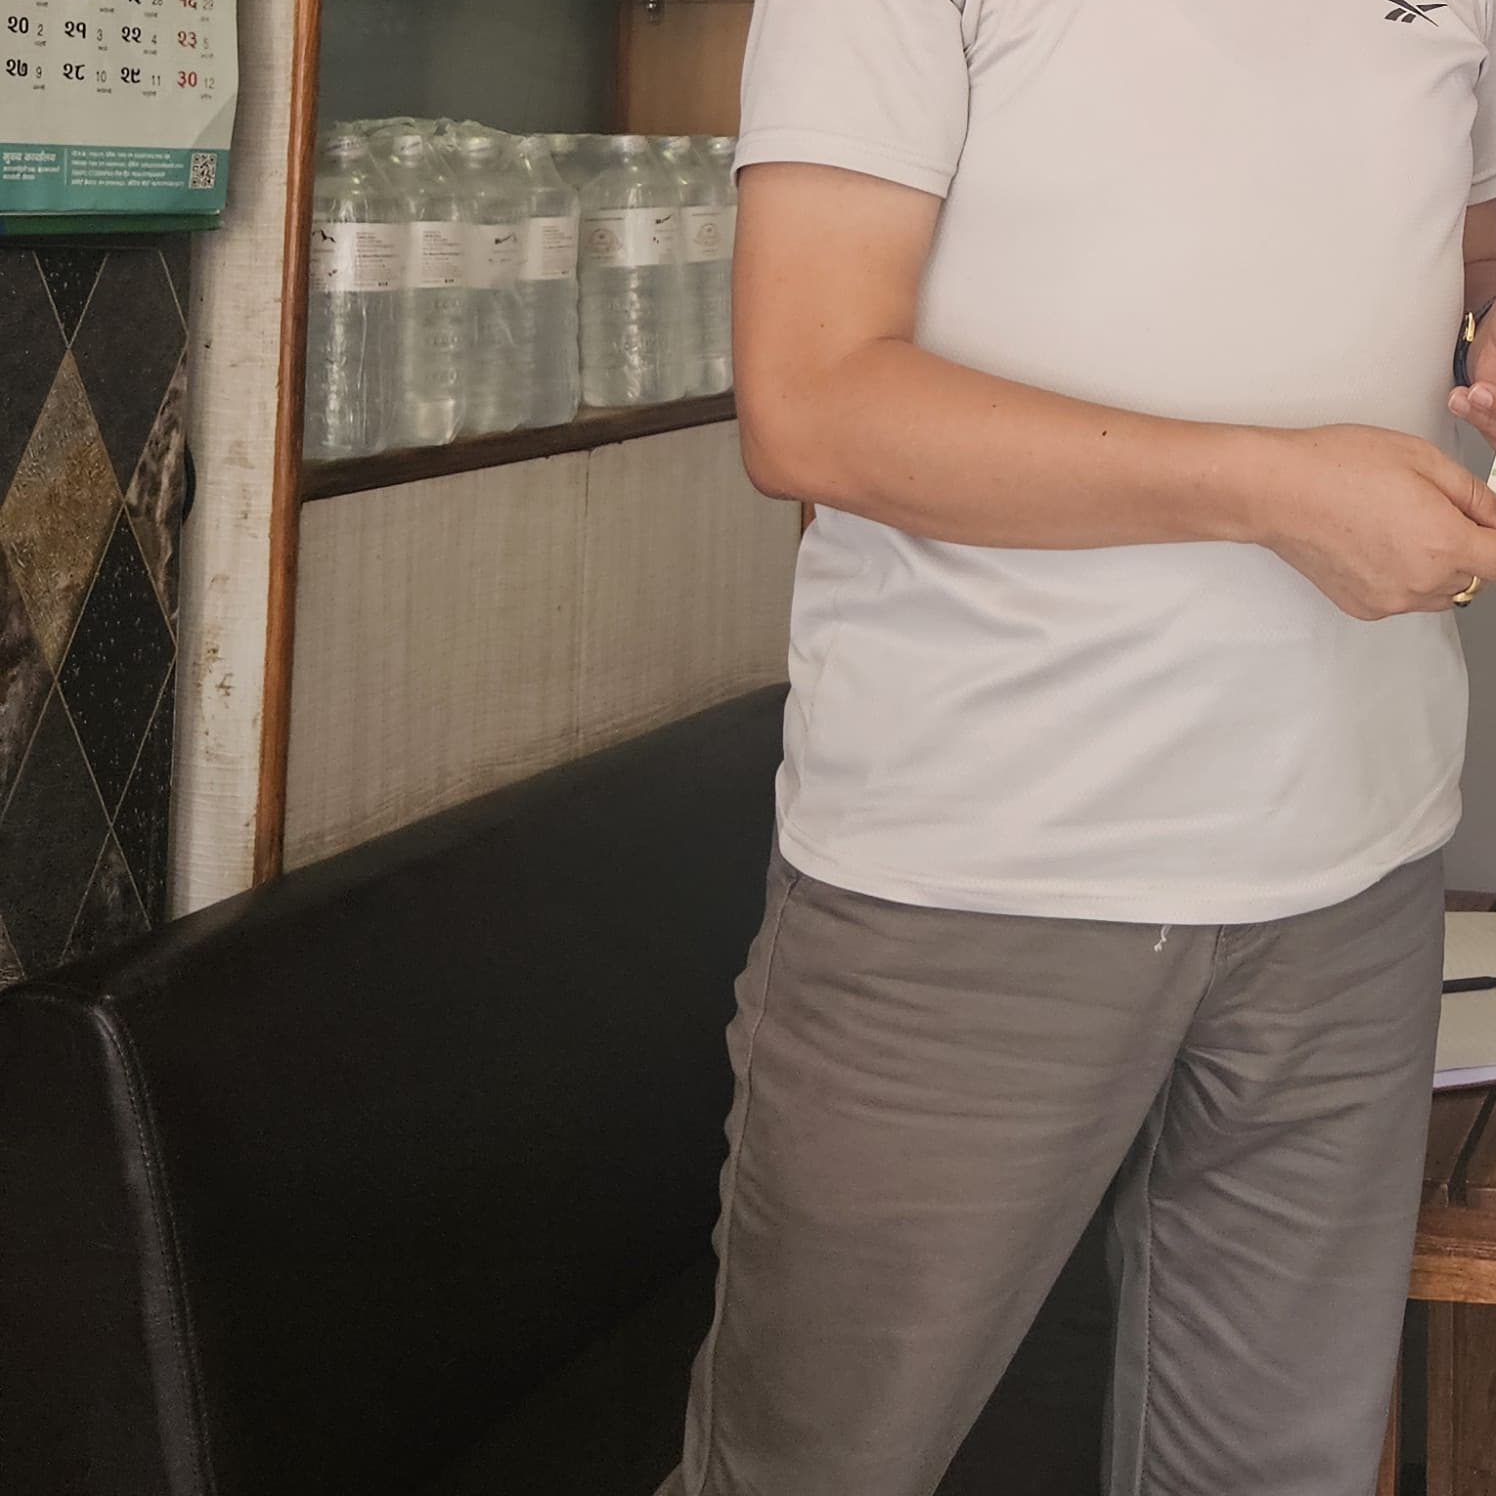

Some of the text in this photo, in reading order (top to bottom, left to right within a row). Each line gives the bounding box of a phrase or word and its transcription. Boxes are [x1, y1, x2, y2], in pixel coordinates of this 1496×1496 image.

[7, 16, 30, 34] २०
[37, 23, 44, 37] 2
[64, 21, 87, 39] २१
[96, 28, 104, 42] 3
[121, 26, 142, 44] २२
[177, 30, 198, 49] २३
[6, 58, 216, 90] २७ 9 २८ 10 २९ 11 ३० 12
